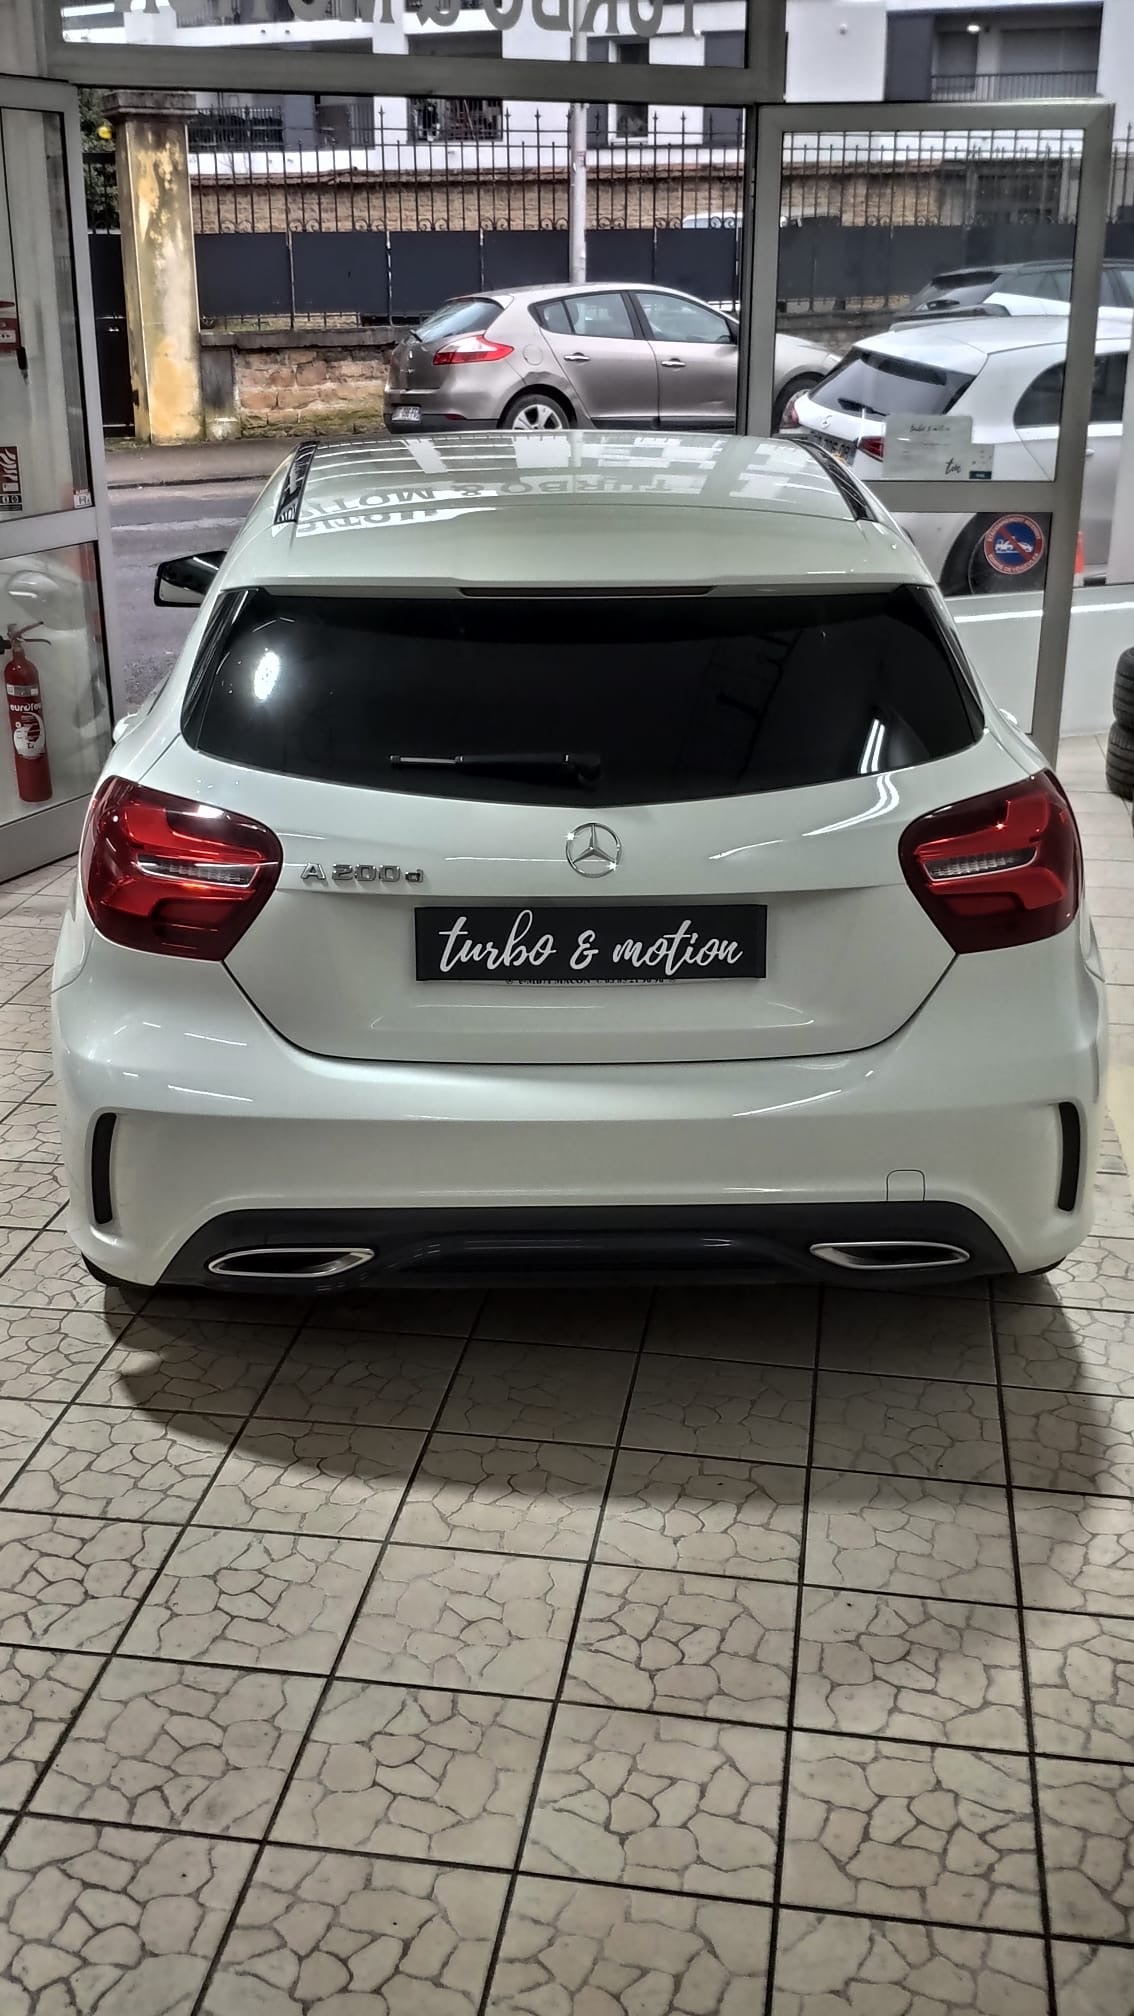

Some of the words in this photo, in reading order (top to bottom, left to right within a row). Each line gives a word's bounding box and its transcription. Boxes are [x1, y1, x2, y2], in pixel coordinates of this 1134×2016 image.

[300, 863, 326, 880] A
[331, 864, 400, 882] 200
[405, 869, 424, 883] d
[438, 909, 557, 973] turbo
[569, 929, 599, 970] &
[612, 919, 743, 976] motion
